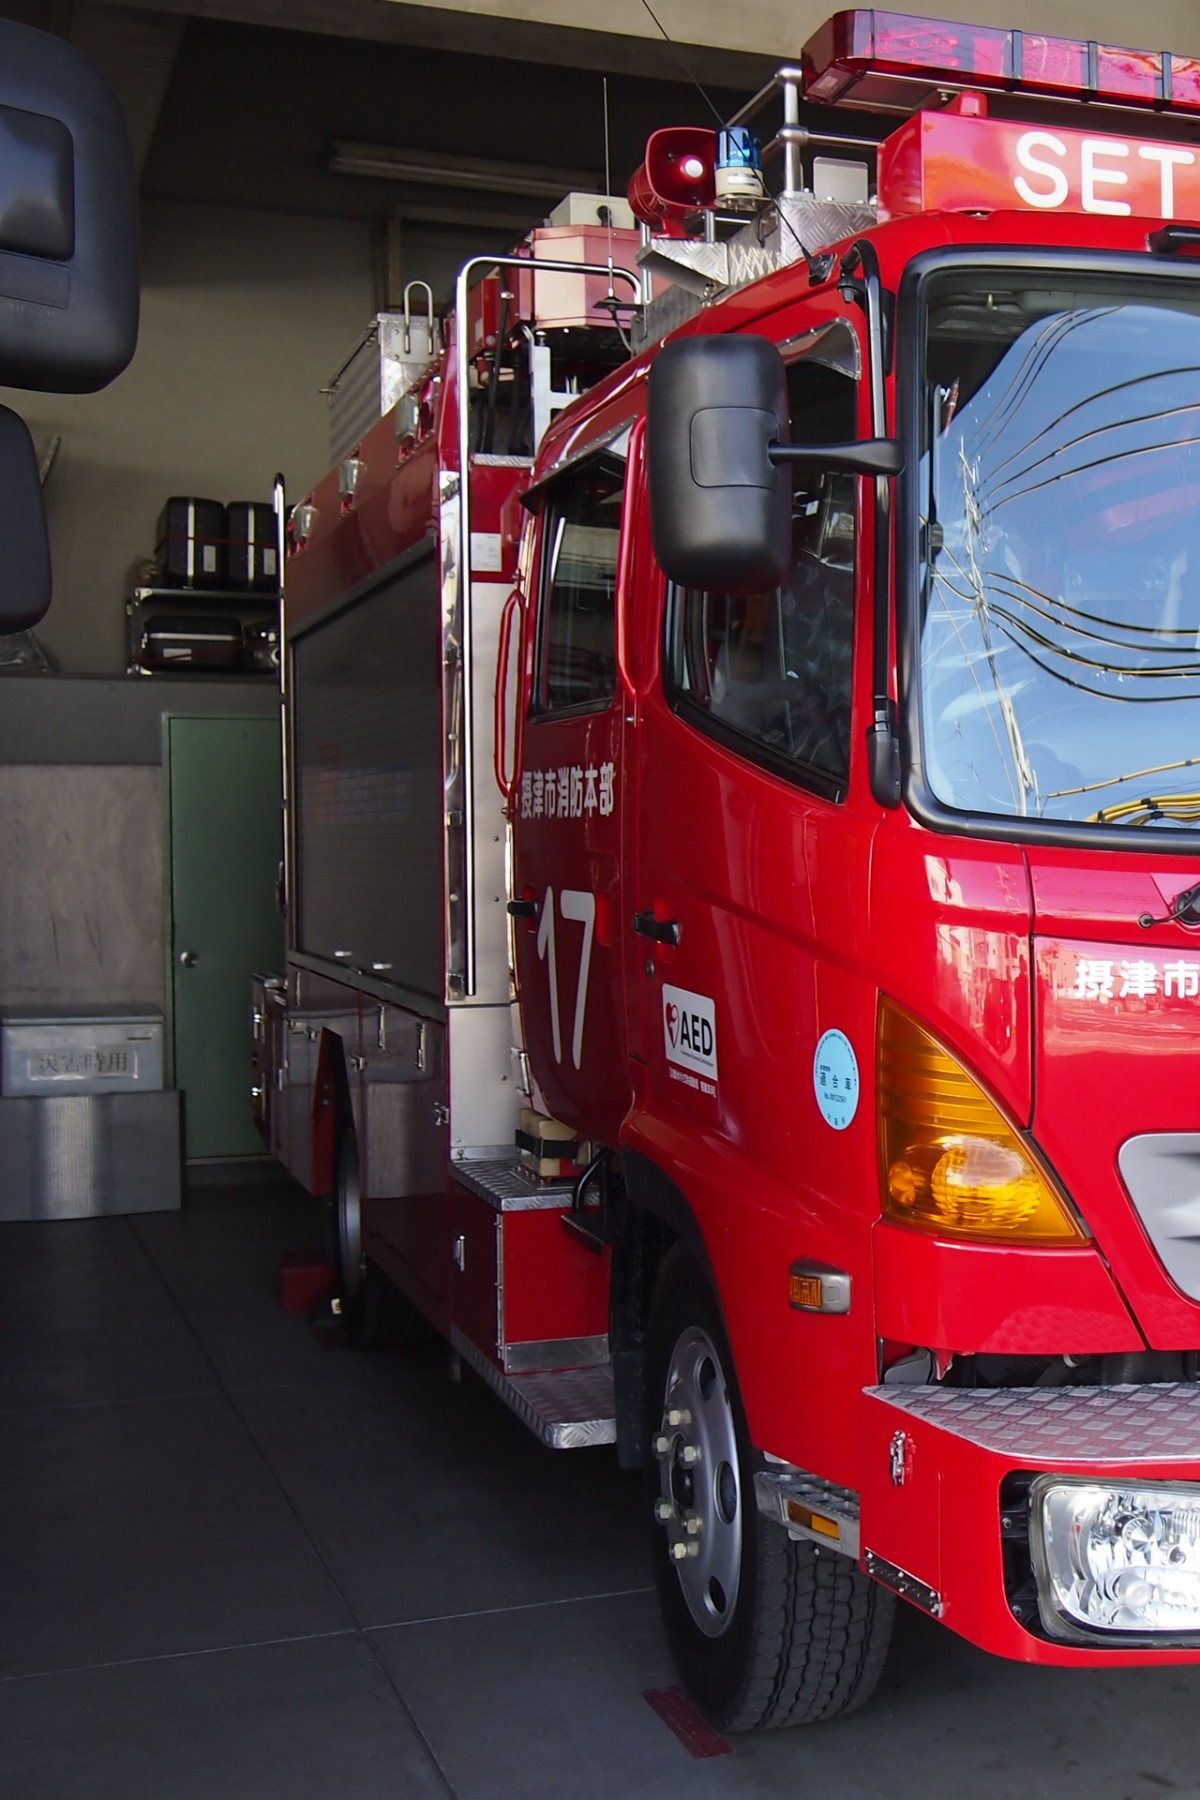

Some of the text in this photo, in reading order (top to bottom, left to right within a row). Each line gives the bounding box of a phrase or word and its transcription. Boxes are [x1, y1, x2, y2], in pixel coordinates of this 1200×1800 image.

[522, 762, 615, 818] 摂津市消防本部
[537, 886, 595, 1070] 17
[680, 1010, 713, 1056] AED
